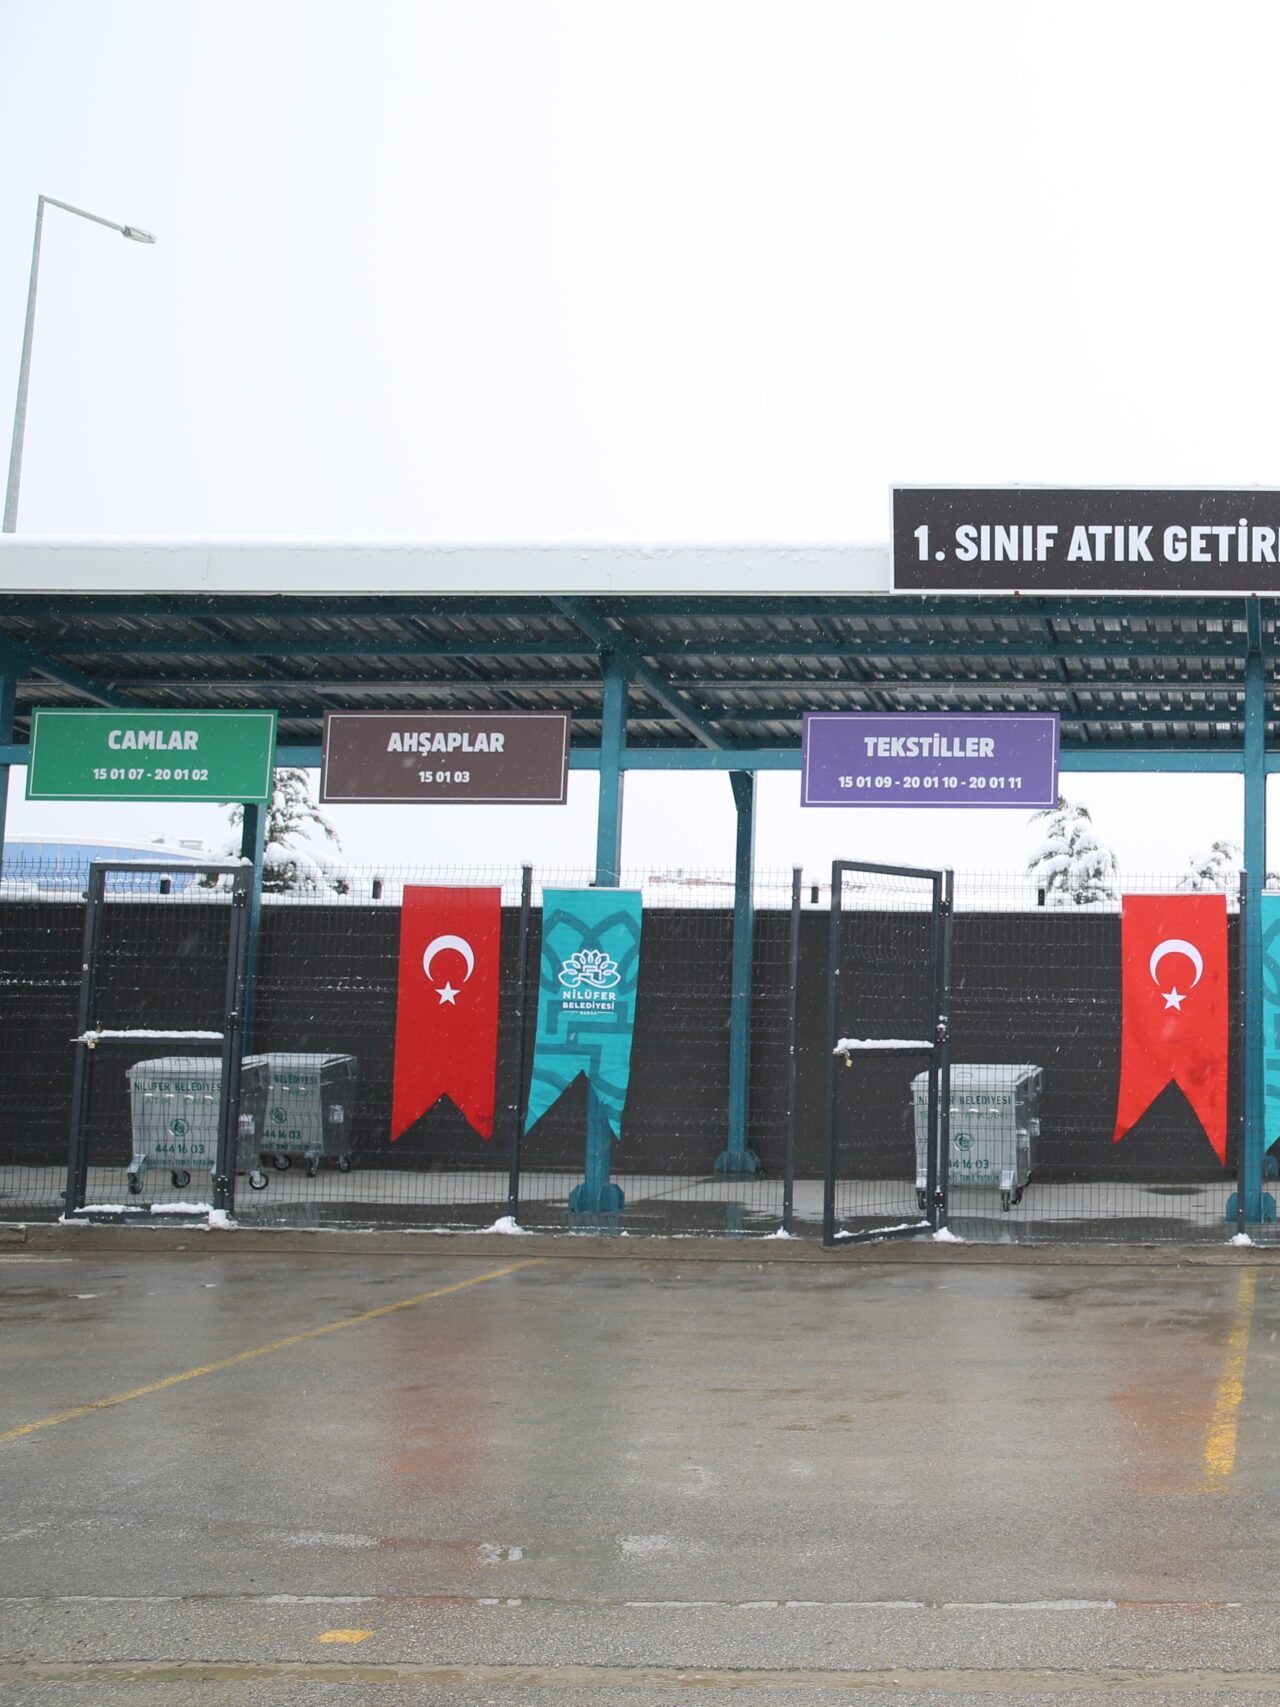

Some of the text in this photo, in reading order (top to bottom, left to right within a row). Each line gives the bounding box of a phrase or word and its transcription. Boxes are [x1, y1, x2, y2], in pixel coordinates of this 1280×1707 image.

[913, 524, 946, 562] 1.
[955, 524, 1059, 562] SINIF
[1066, 525, 1154, 562] ATIK
[107, 729, 199, 751] CAMLAR
[386, 732, 505, 757] AHŞAPLAR
[863, 732, 995, 758] TEKSTİLLER
[92, 767, 108, 780] 15
[109, 767, 126, 780] 01
[127, 768, 145, 780] 07
[154, 768, 172, 781] 20
[173, 768, 189, 781] 01
[191, 768, 209, 781] 02
[418, 770, 470, 783] 15 01 03
[838, 775, 854, 788] 15
[855, 775, 872, 788] 01
[874, 776, 893, 788] 09
[902, 776, 921, 789] 20
[923, 776, 939, 789] 01
[942, 776, 958, 789] 10
[968, 776, 987, 789] 20
[988, 776, 1005, 789] 01
[1007, 776, 1022, 789] 11
[562, 988, 617, 1001] NİLÜFER
[562, 1001, 615, 1010] BELEDİYESİ
